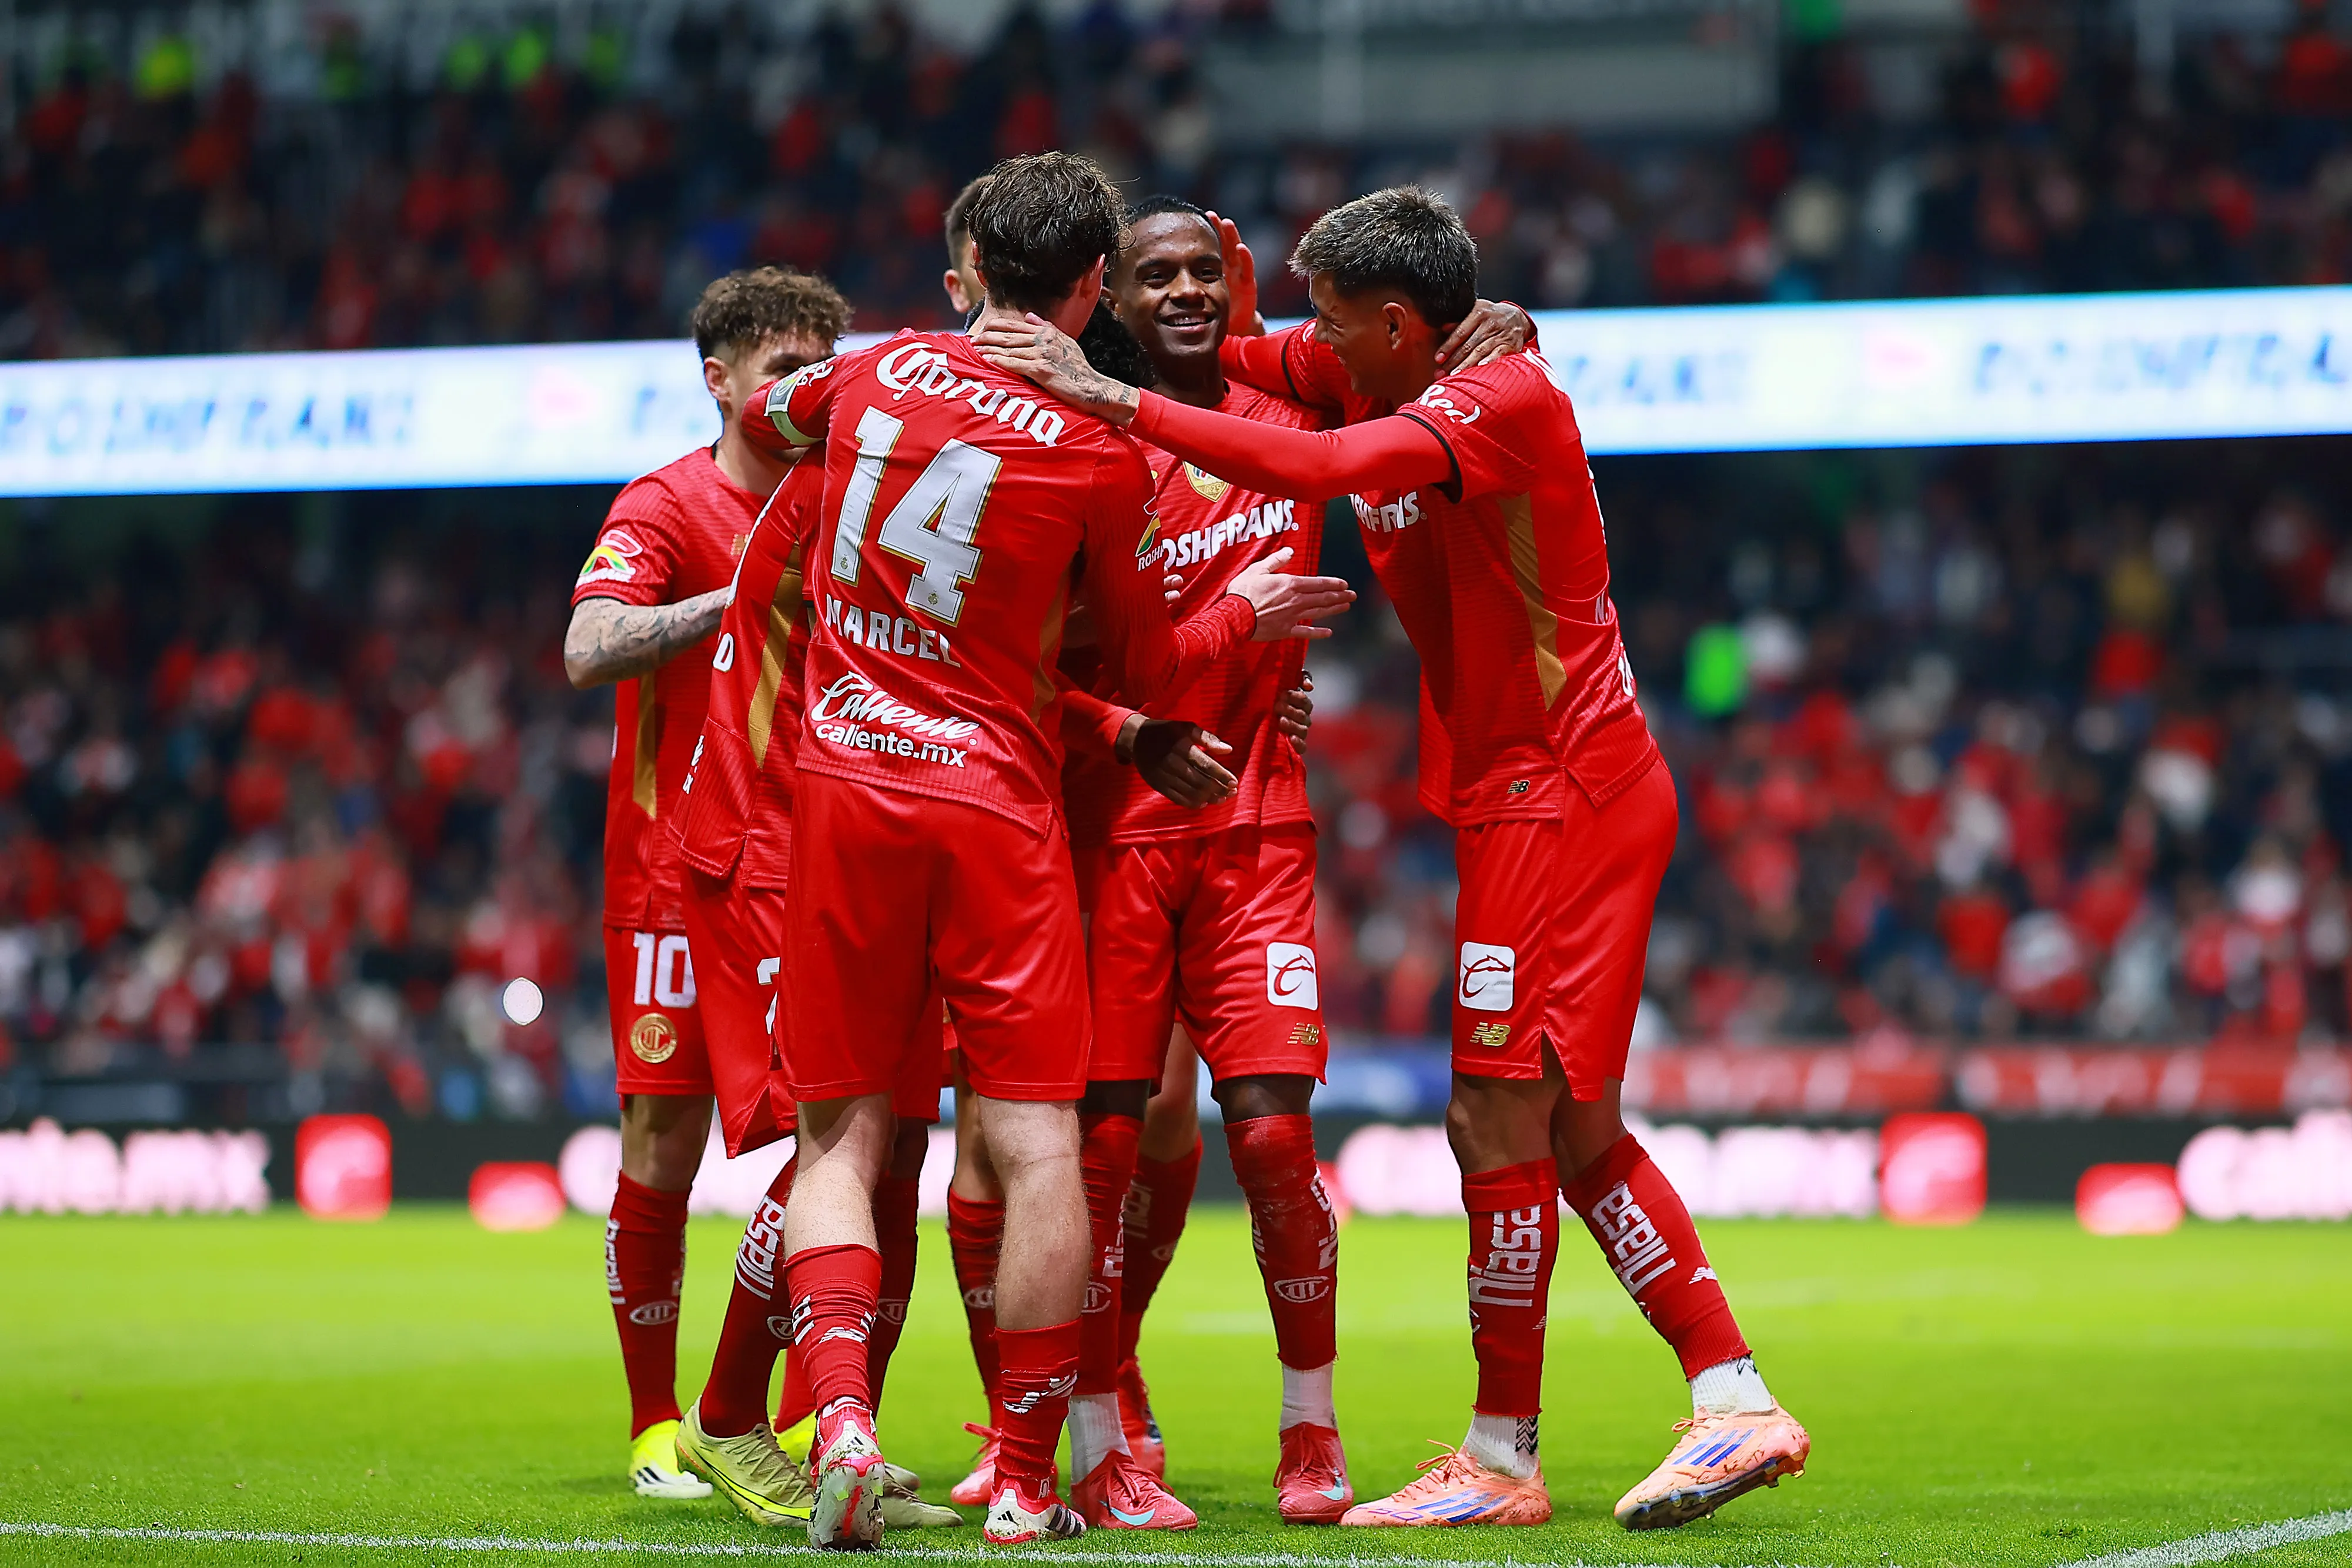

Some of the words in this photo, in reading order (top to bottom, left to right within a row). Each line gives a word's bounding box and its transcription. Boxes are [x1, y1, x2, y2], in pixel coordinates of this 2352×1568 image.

[876, 342, 1065, 446] Corona
[830, 405, 1003, 627] 14
[1162, 499, 1295, 568] OSHFRANS
[825, 593, 961, 668] MARCEL
[810, 670, 980, 740] Caliente
[815, 723, 967, 768] caliente.mx
[633, 931, 697, 1008] 10
